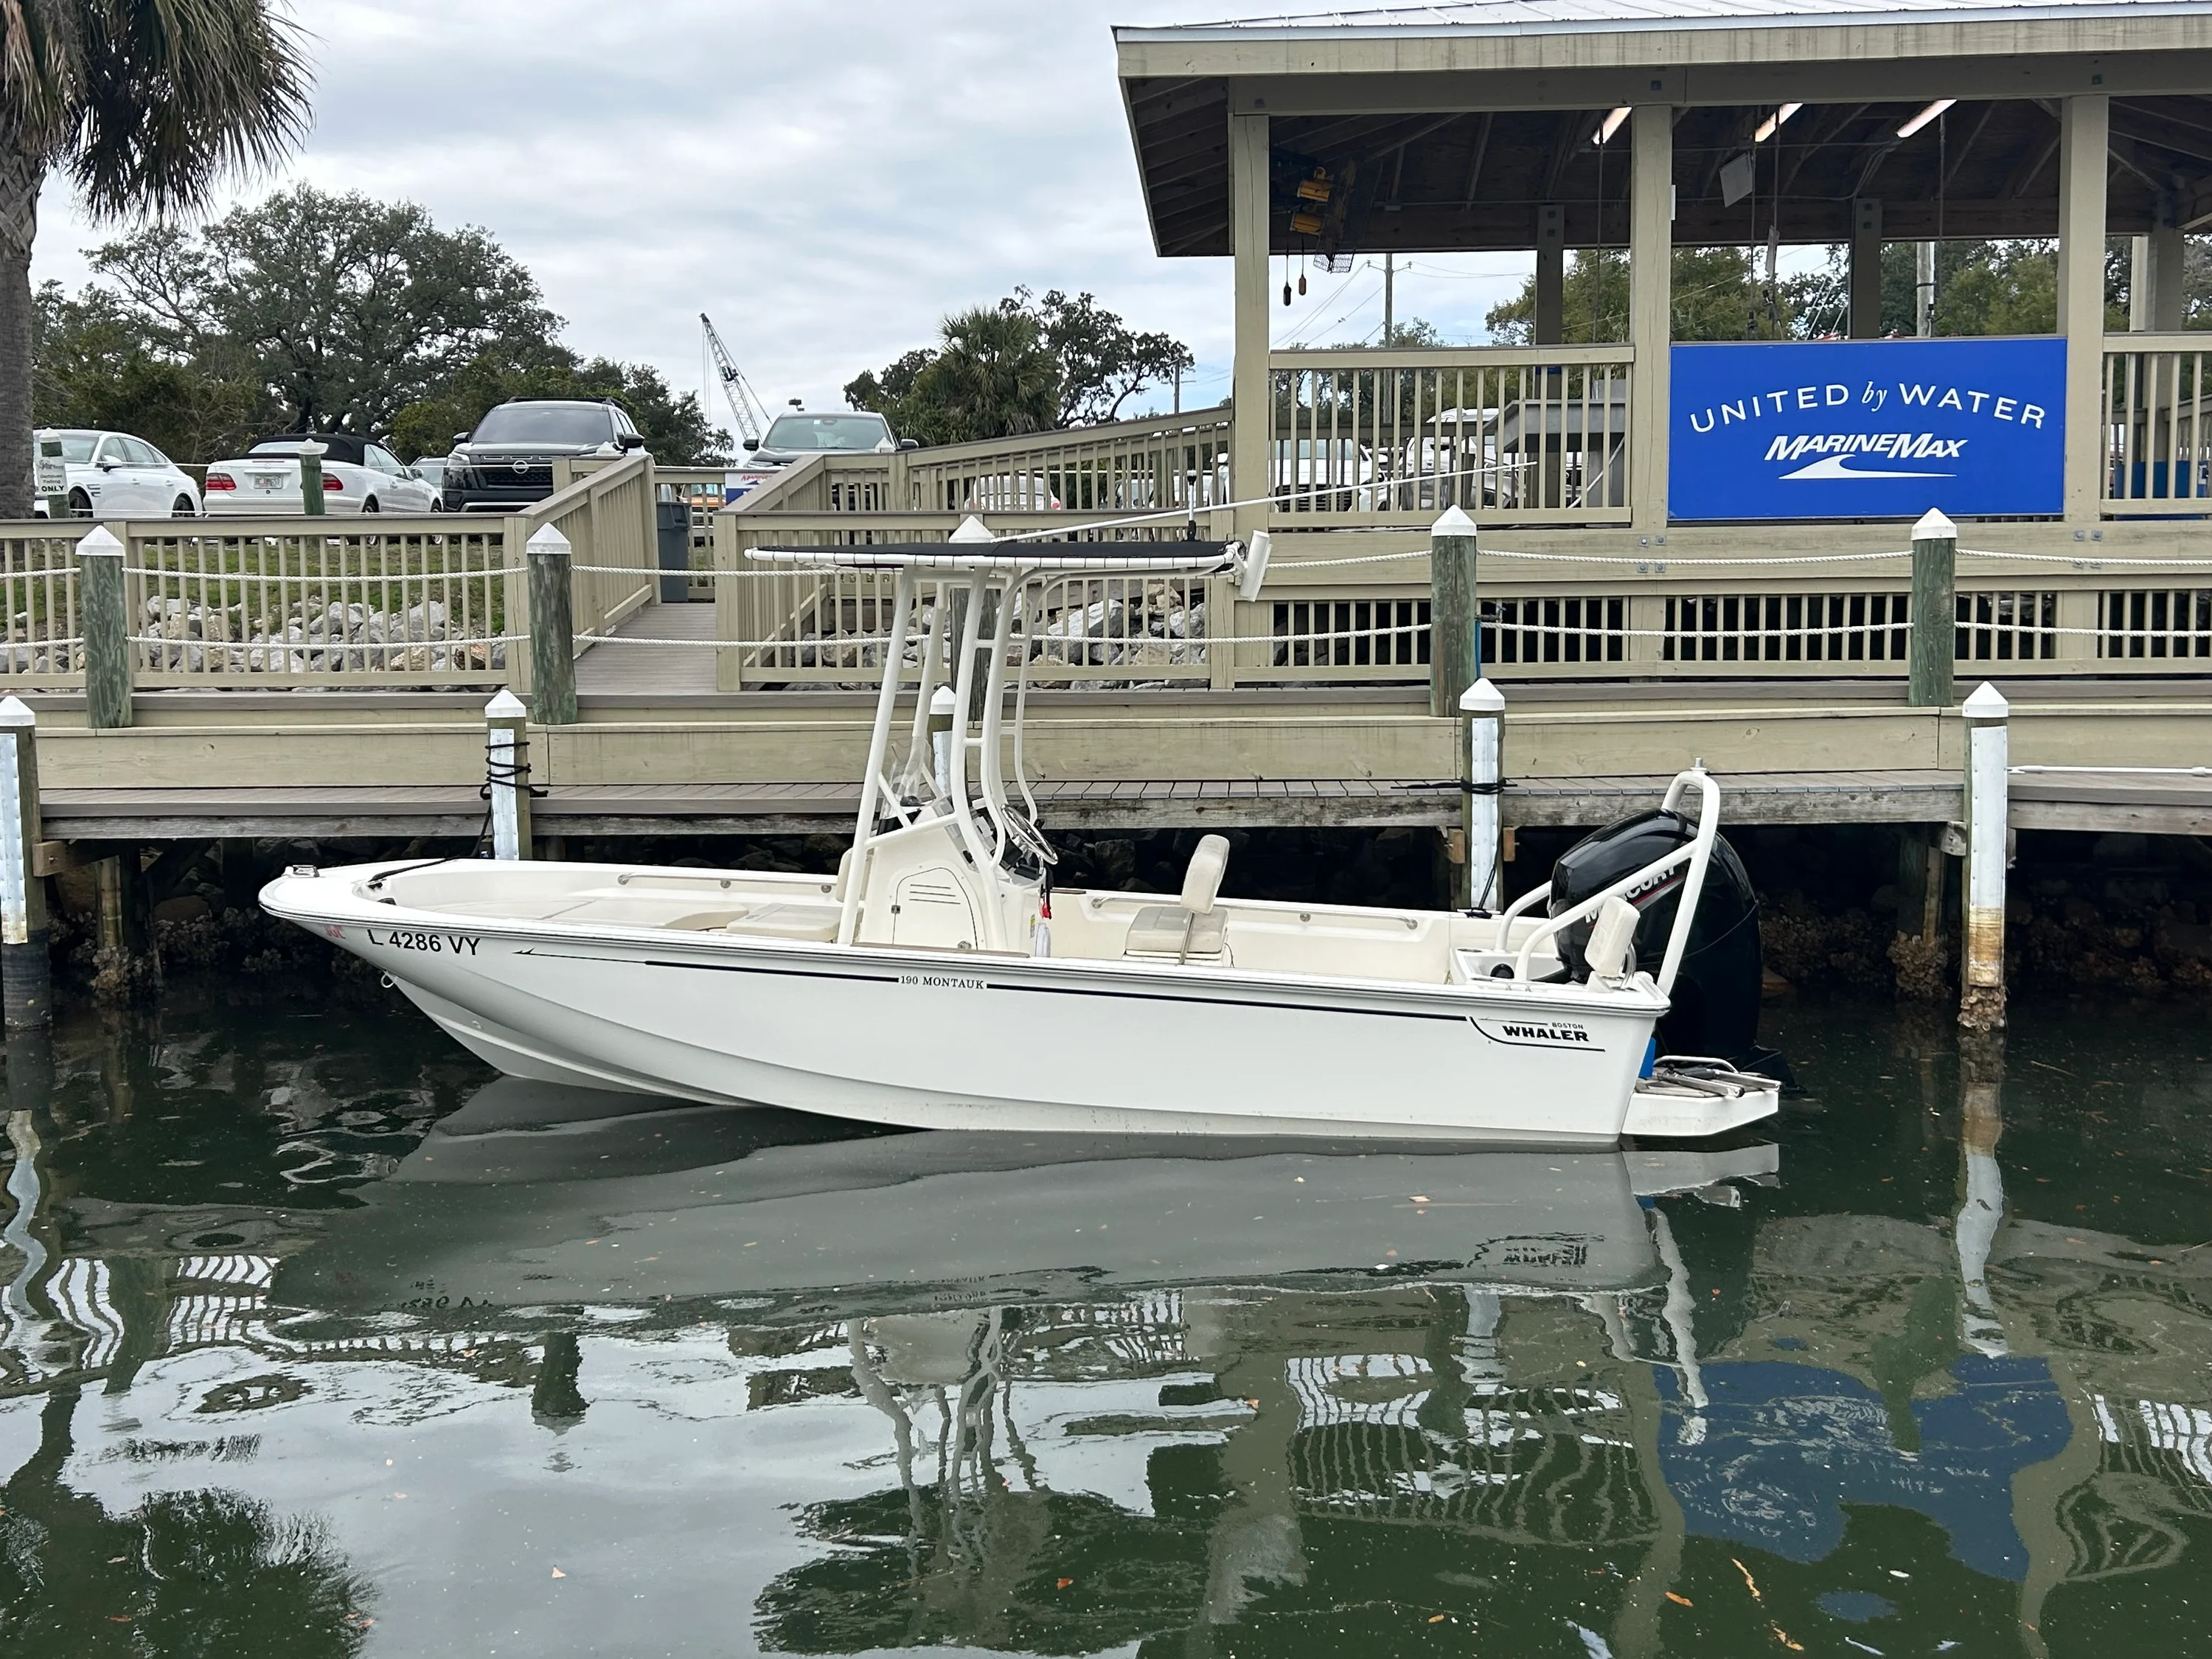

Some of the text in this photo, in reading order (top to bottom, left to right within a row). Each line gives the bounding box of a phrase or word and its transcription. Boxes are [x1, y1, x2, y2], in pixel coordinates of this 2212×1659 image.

[1690, 380, 2046, 434] UNITED by WATER
[1585, 866, 1675, 923] MCURY
[389, 931, 442, 953] 4286
[447, 935, 481, 956] VY
[900, 975, 984, 990] 190 MONTAUK
[1502, 1025, 1590, 1042] WHALER
[1551, 1022, 1584, 1030] BOSTON
